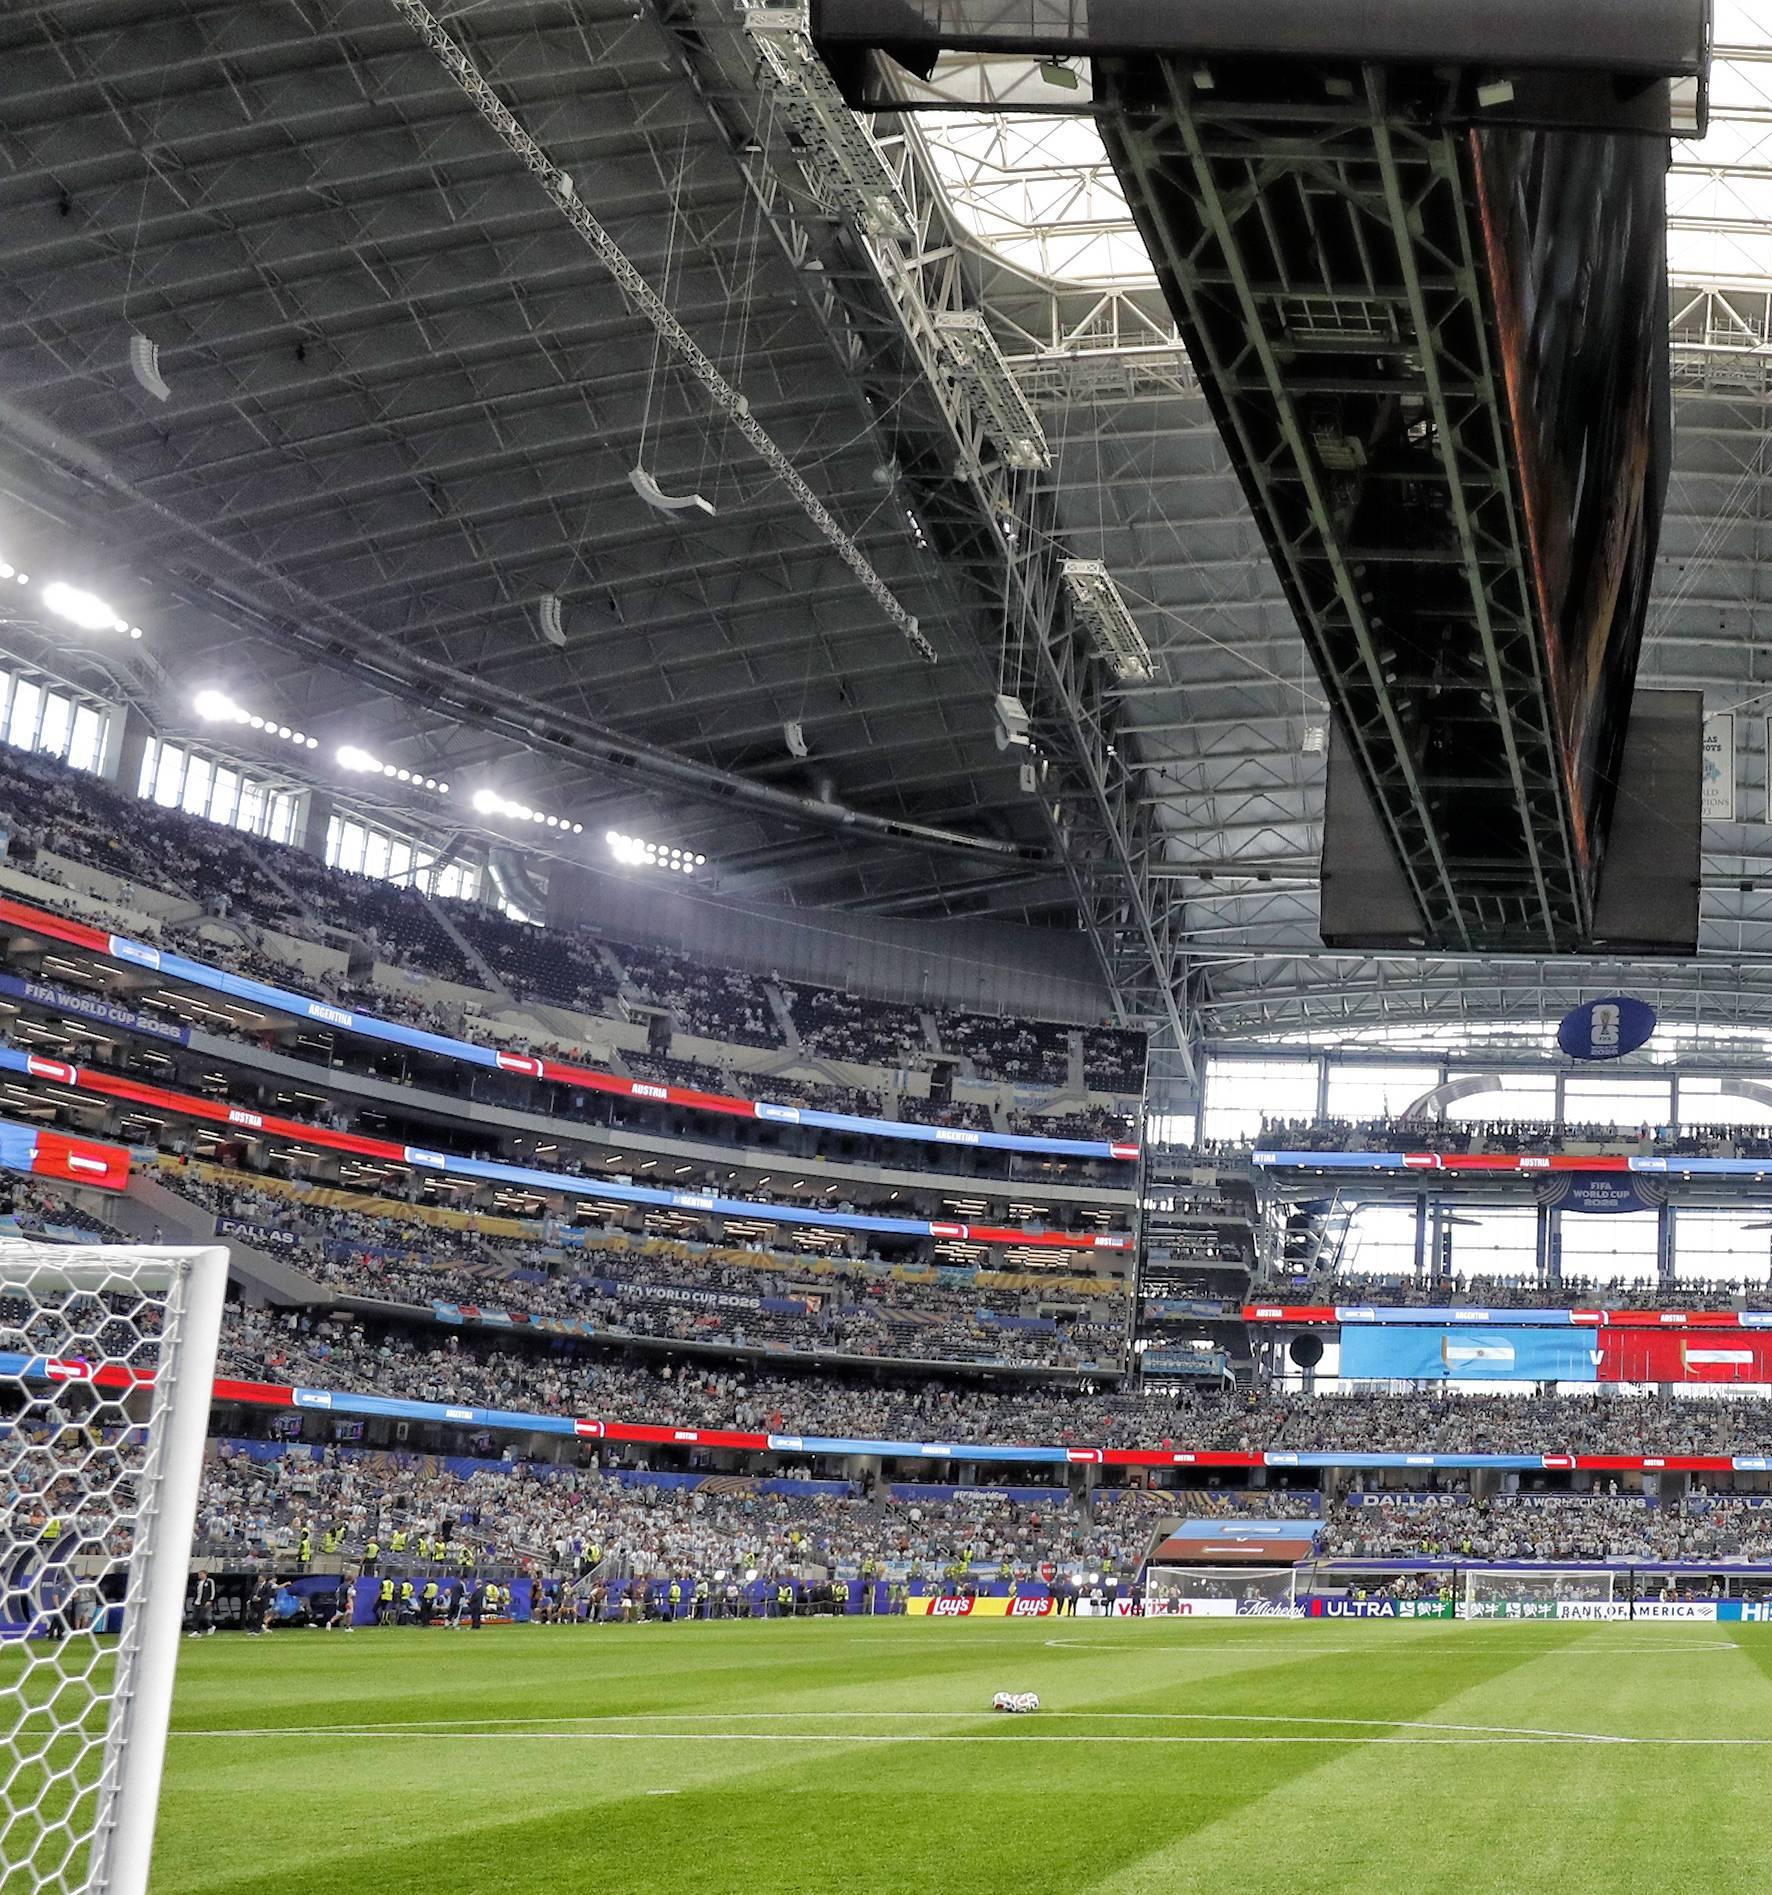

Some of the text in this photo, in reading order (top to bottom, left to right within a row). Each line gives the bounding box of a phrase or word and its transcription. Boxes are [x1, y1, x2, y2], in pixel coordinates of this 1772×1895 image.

[24, 983, 181, 1038] FIFA WORLD CUP 2026
[308, 1002, 353, 1028] ARGENTINA
[631, 1083, 667, 1099] AUSTRIA
[228, 1108, 263, 1128] AUSTRIA
[936, 1130, 979, 1144] ARGENTINA
[1519, 1157, 1550, 1167] AUSTRIA
[1573, 1190, 1609, 1198] WORLD
[1590, 1182, 1612, 1190] FIFA
[222, 1220, 295, 1245] DALLAS
[646, 1286, 690, 1301] WORLD
[717, 1296, 761, 1309] 2026
[1363, 1495, 1455, 1507] DALLAS
[932, 1597, 970, 1616] Lay's
[1012, 1597, 1049, 1616] Lay's
[1327, 1601, 1394, 1617] ULTRA
[1562, 1605, 1605, 1617] BANK
[1632, 1606, 1695, 1617] AMERICA
